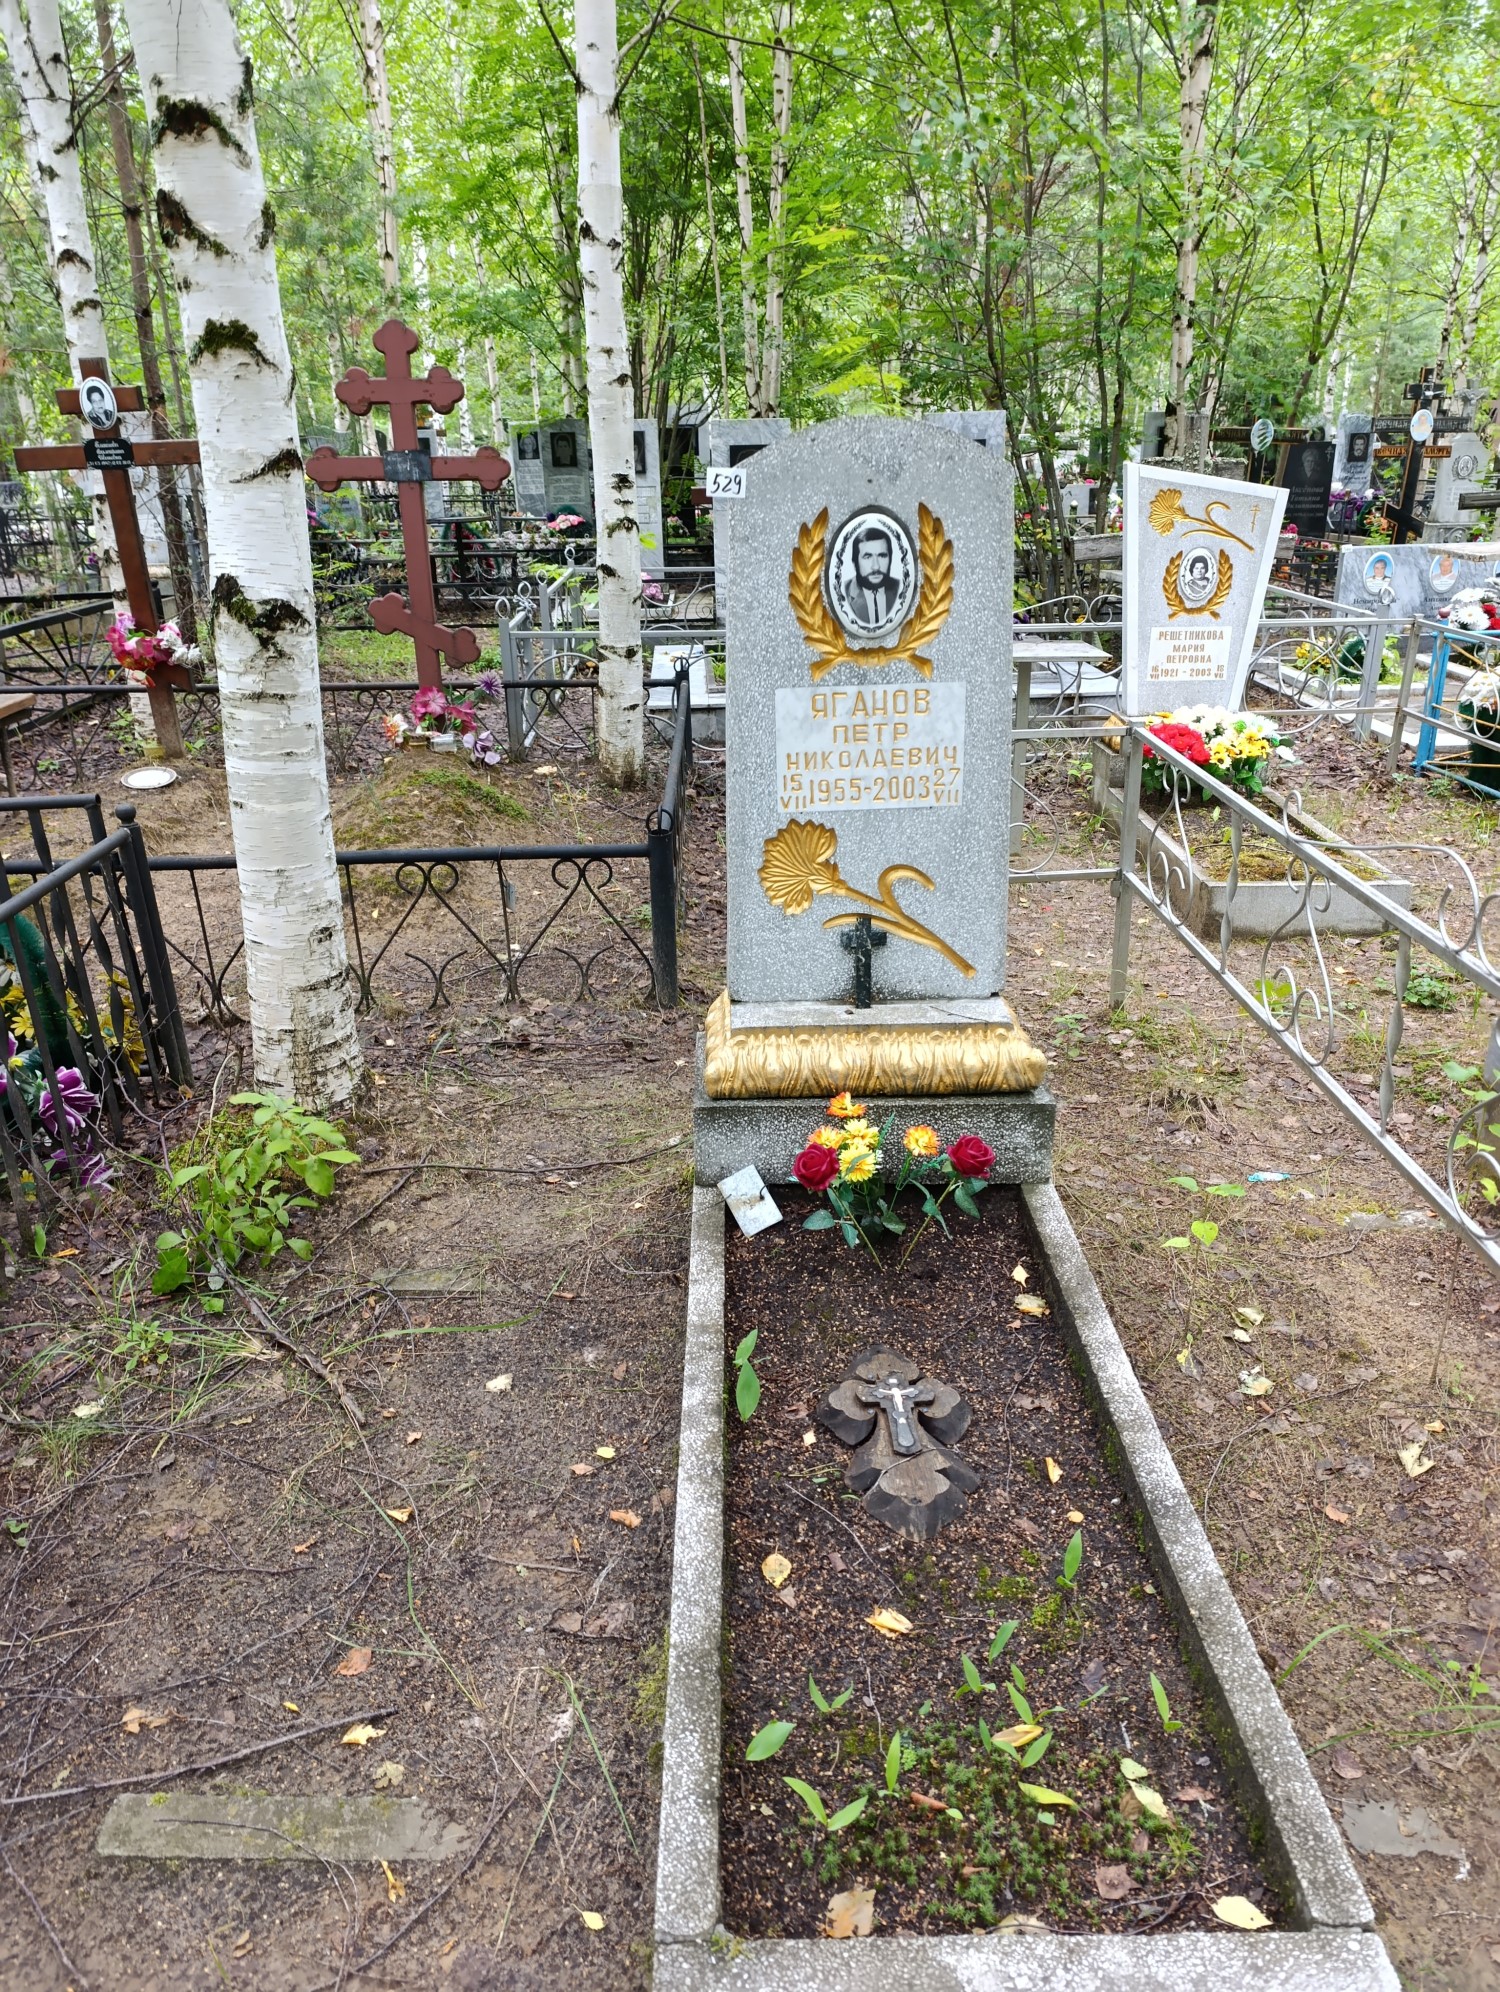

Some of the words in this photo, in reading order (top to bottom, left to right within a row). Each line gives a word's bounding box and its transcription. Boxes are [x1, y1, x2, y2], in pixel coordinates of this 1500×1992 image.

[711, 473, 742, 495] 529
[1158, 630, 1224, 641] РЕШЕТНИКОВА
[1172, 643, 1205, 653] МАРИЯ
[1166, 654, 1212, 664] ПЕТРОВНА
[1160, 668, 1179, 678] 1921
[1189, 668, 1212, 677] 2003
[811, 688, 931, 721] ЯГАНОВ
[833, 722, 909, 744] ПЕТР
[786, 745, 958, 772] НИКОЛАЕВИЧ
[782, 773, 803, 793] 15
[933, 767, 961, 789] 27
[780, 795, 808, 810] VII
[933, 789, 959, 804] VII
